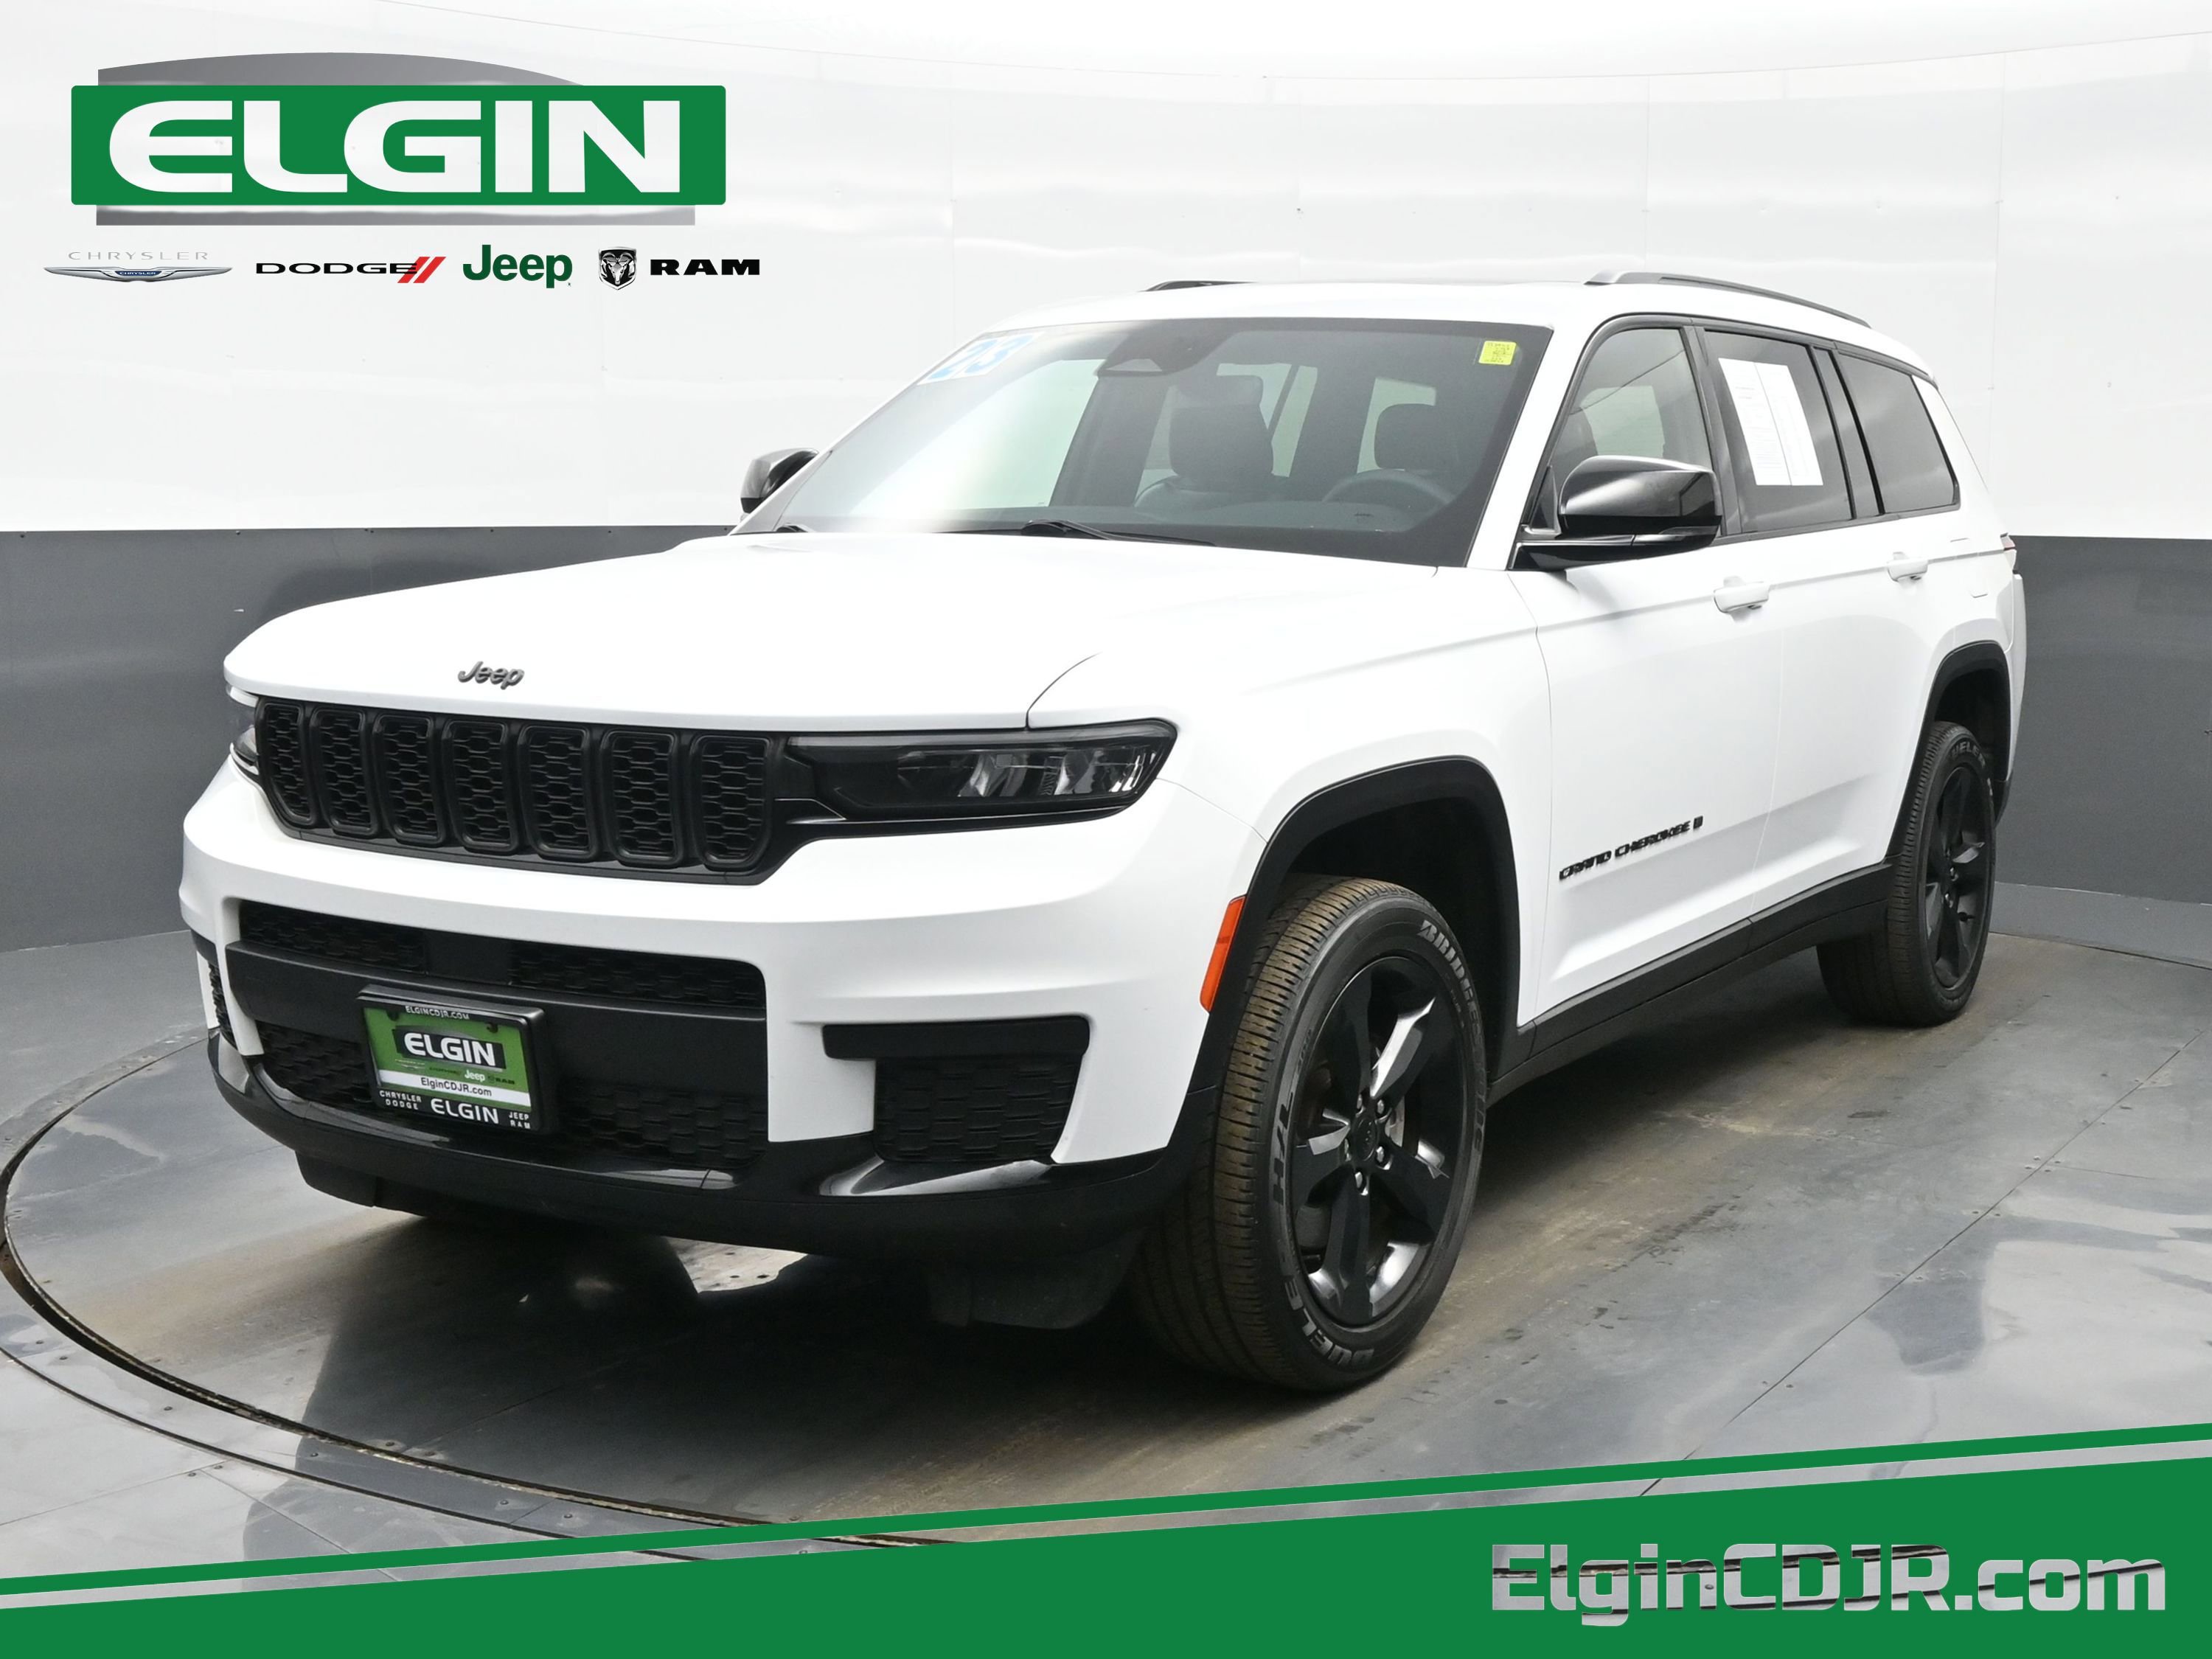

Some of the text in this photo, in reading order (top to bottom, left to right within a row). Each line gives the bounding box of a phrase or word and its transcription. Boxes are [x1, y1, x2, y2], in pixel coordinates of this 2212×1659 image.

[457, 661, 525, 690] Jeep
[1558, 850, 1613, 881] GRAND
[1614, 821, 1691, 859] CHEROKEE
[405, 1005, 470, 1020] ELGINCDJR.COM
[404, 1032, 496, 1066] ELGIN
[465, 1069, 486, 1083] Jeep
[420, 1077, 493, 1097] ElginCDJR.com
[379, 1090, 422, 1103] CHRYSLER
[385, 1099, 419, 1110] DODGE
[431, 1098, 499, 1124] ELGIN
[509, 1111, 529, 1121] JEEP
[509, 1119, 531, 1130] RAM
